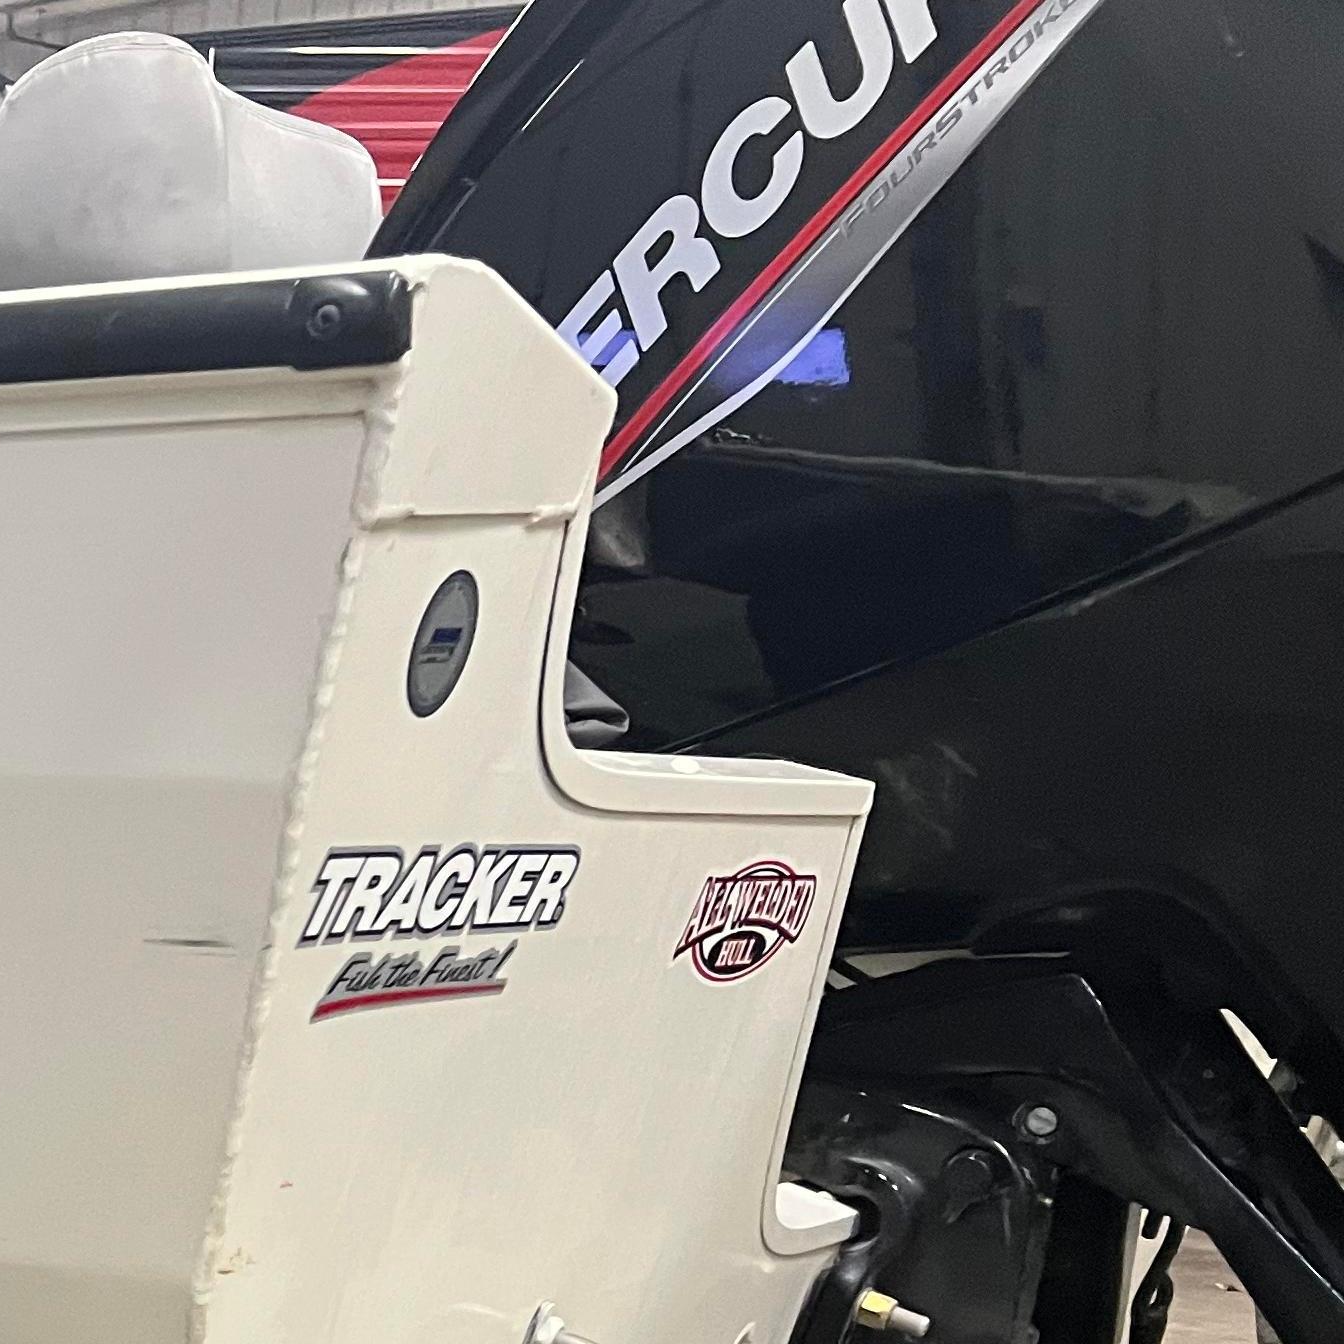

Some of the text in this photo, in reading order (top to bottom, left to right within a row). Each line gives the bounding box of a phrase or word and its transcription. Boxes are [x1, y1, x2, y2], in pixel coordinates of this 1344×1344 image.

[556, 0, 938, 390] ERCU
[300, 848, 580, 943] TRACKER
[382, 957, 420, 989] the
[714, 937, 757, 968] HULL
